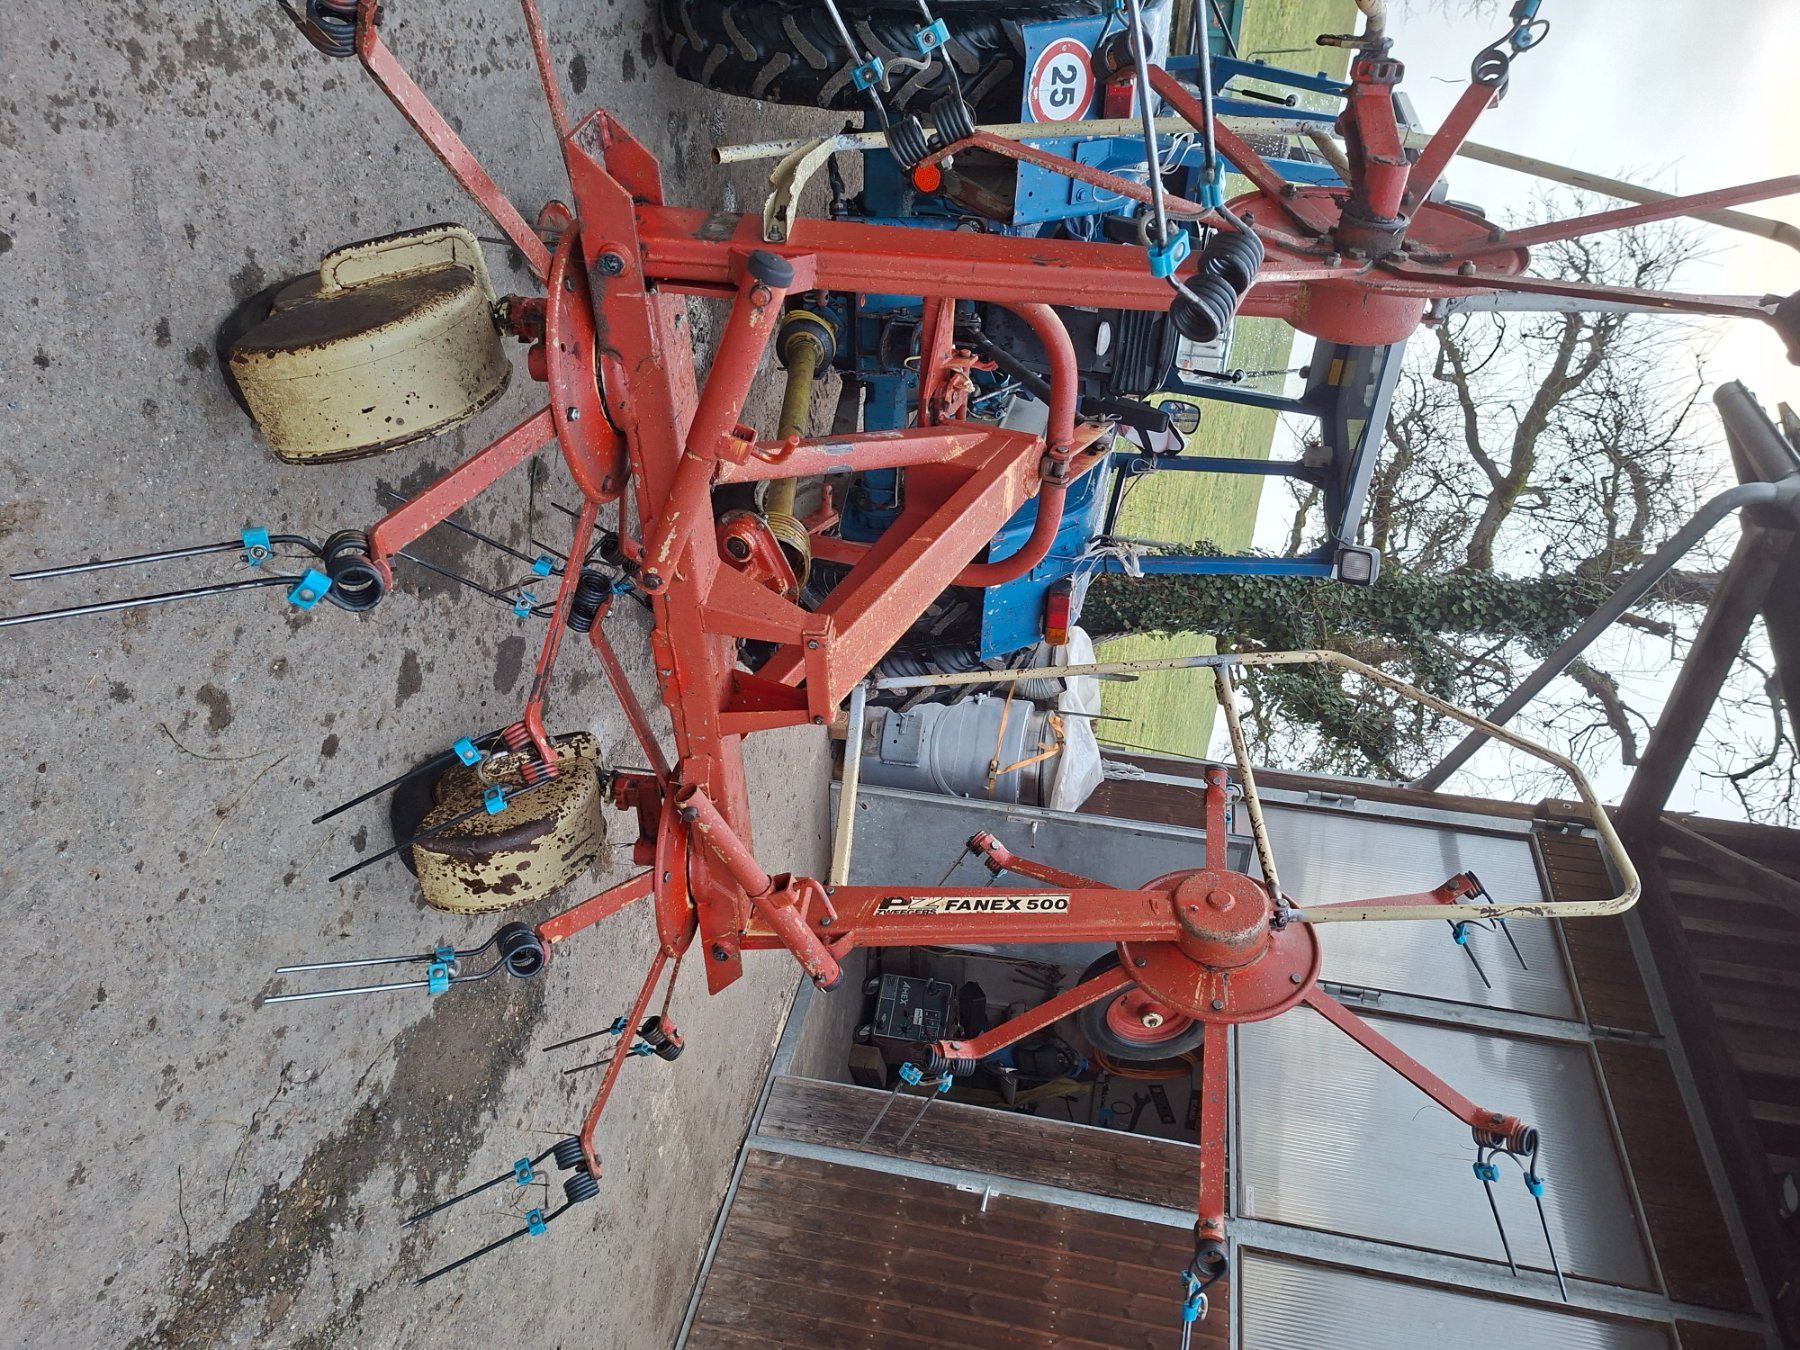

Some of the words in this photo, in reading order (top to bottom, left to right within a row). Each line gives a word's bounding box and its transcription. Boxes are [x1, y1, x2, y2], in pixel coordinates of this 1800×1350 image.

[1049, 64, 1078, 108] 25
[879, 897, 943, 910] PZ
[944, 899, 1022, 911] FANEX
[1026, 898, 1068, 910] 500
